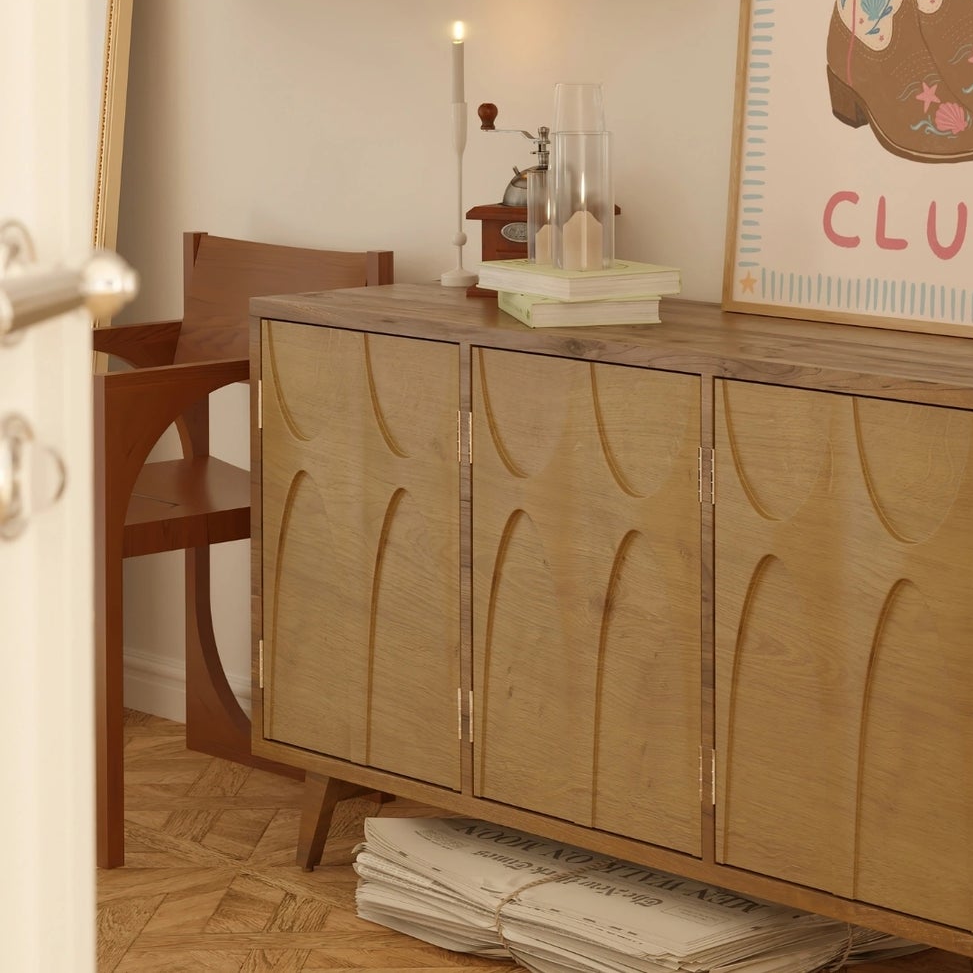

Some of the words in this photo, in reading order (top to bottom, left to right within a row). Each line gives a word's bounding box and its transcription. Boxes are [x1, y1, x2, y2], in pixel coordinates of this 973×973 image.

[455, 826, 546, 852] MOON
[471, 851, 533, 871] Times
[542, 848, 593, 865] ON
[530, 866, 588, 885] Yrk
[578, 877, 627, 897] New
[625, 891, 664, 907] The
[684, 889, 768, 914] MEN
